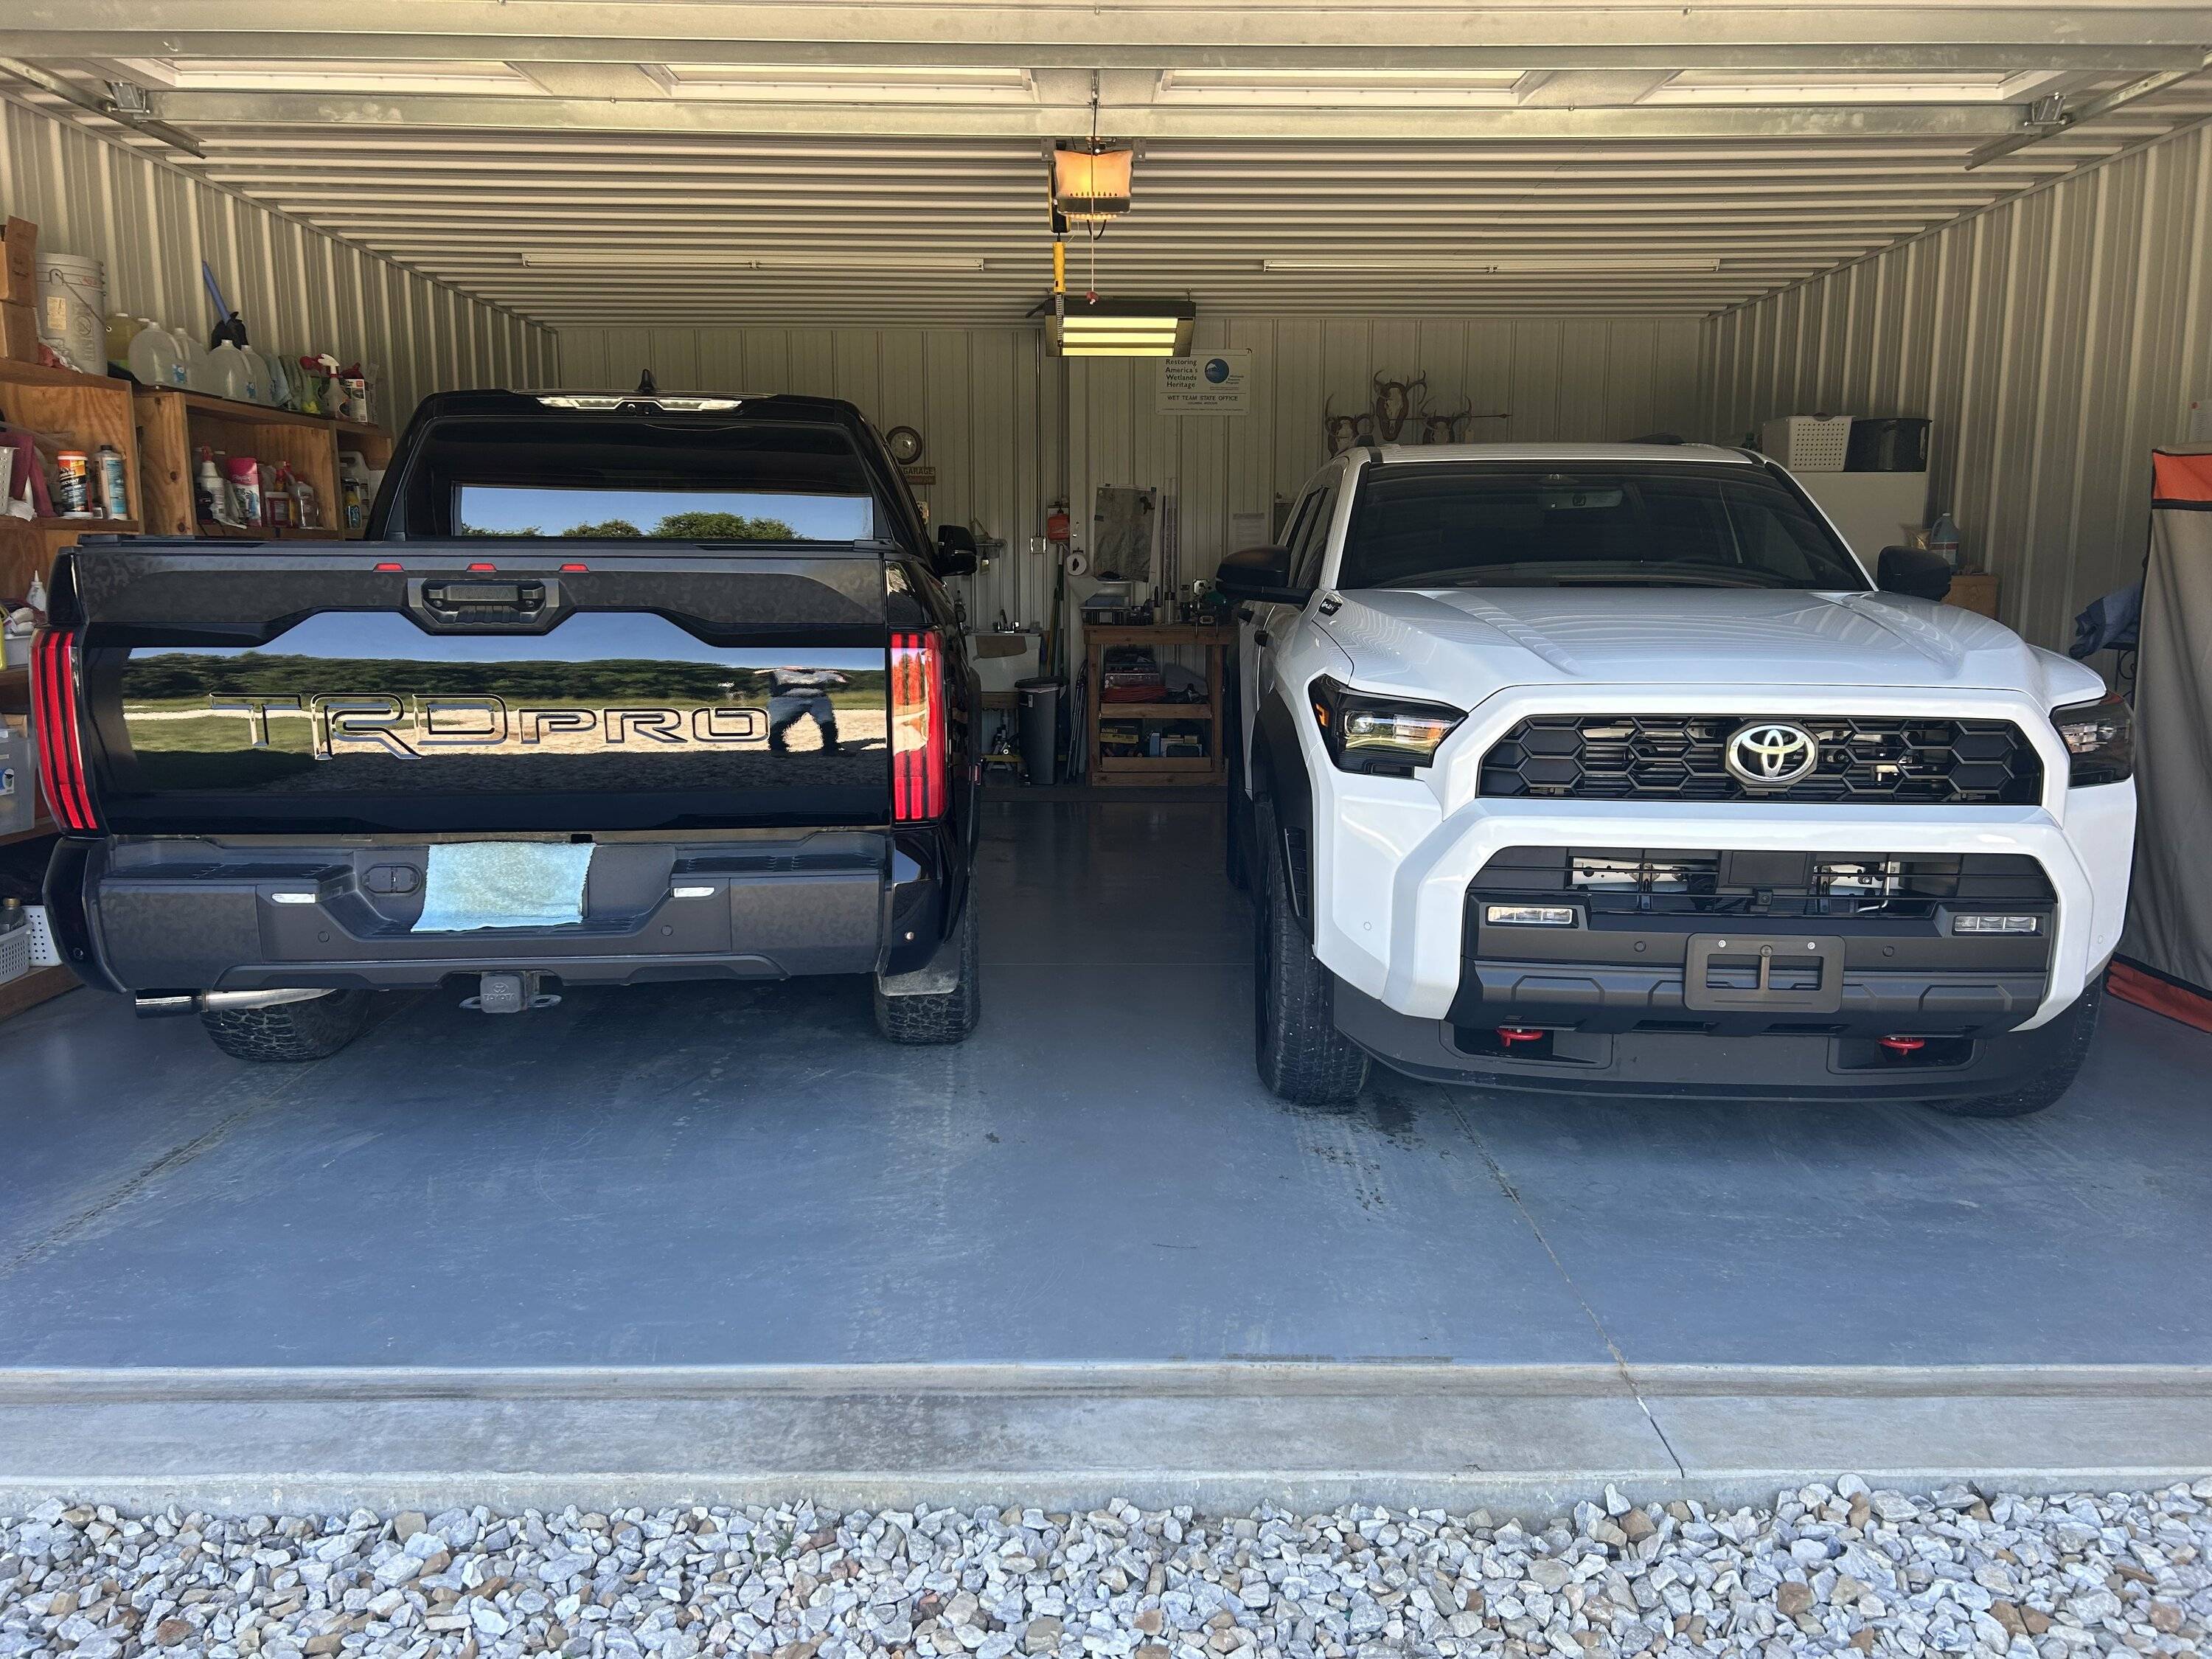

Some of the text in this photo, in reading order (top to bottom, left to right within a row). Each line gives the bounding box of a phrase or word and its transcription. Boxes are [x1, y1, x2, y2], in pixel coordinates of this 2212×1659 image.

[455, 588, 512, 599] TOYOTA
[210, 692, 770, 761] TRD PRO
